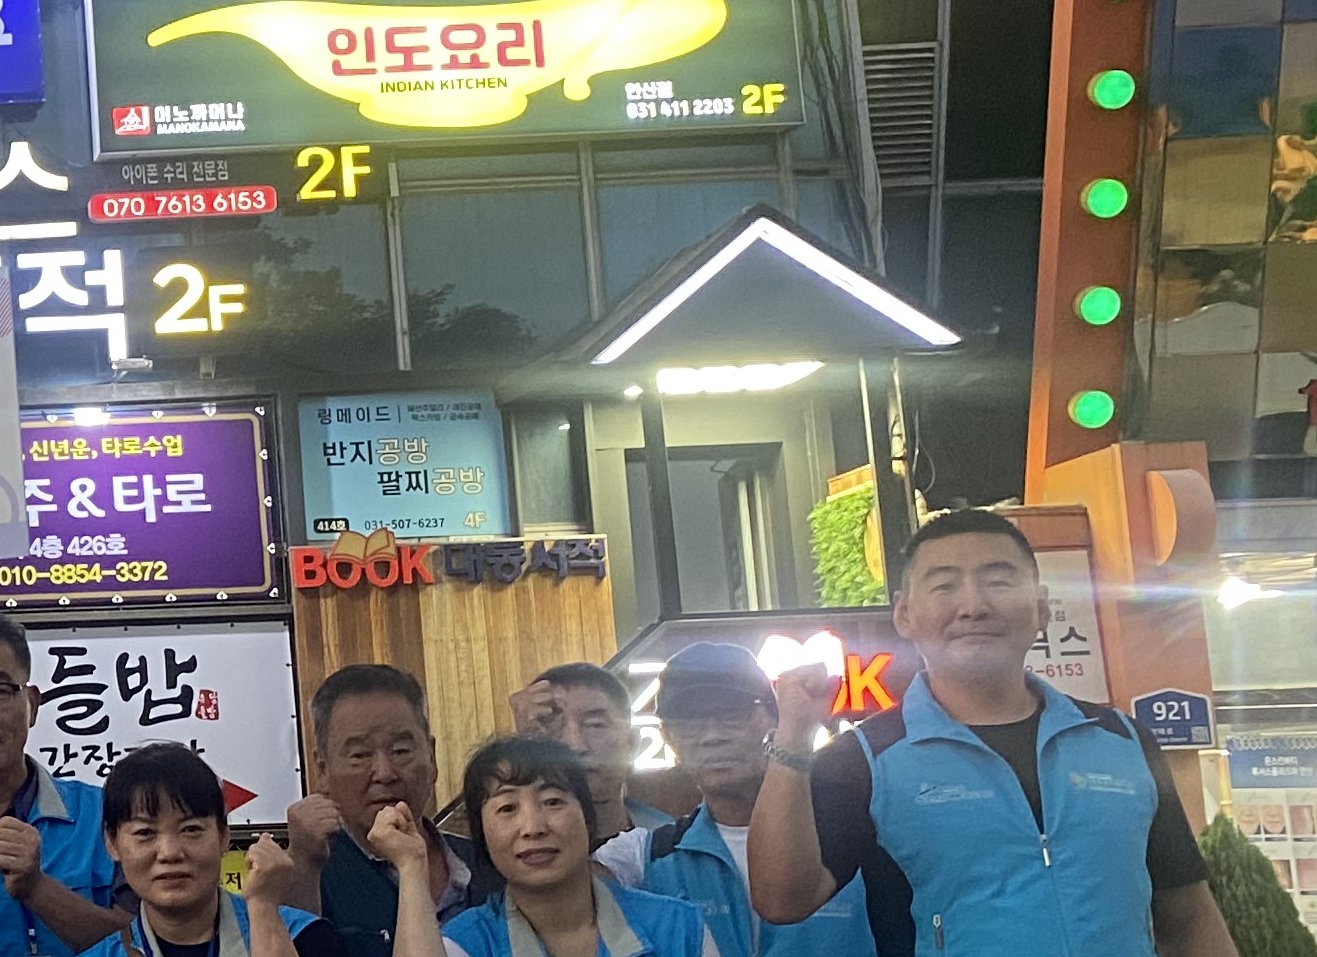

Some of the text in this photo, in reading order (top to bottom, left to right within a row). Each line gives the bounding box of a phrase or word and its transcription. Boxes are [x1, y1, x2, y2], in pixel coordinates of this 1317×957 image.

[327, 19, 545, 76] 인도요리
[380, 77, 508, 93] INDIAN KITCHEN
[740, 83, 785, 114] 2F
[626, 101, 657, 119] 031
[692, 98, 735, 115] 2203
[122, 160, 229, 185] 아이폰 수리 전문점
[295, 145, 371, 201] 2F
[103, 191, 266, 218] 070 7613 6153
[152, 262, 249, 336] 2F
[317, 405, 391, 424] 링메이드
[29, 434, 184, 462] 신년운, 타로수업
[322, 437, 430, 466] 반지공방
[377, 467, 485, 496] 팔찌공방
[67, 477, 106, 518] &
[112, 472, 213, 524] 타로
[364, 517, 445, 531] 031-507-6237
[464, 511, 487, 529] 4F
[29, 533, 128, 559] 4층 426호
[293, 539, 606, 589] BOOK 대동서적
[1152, 700, 1191, 721] 921
